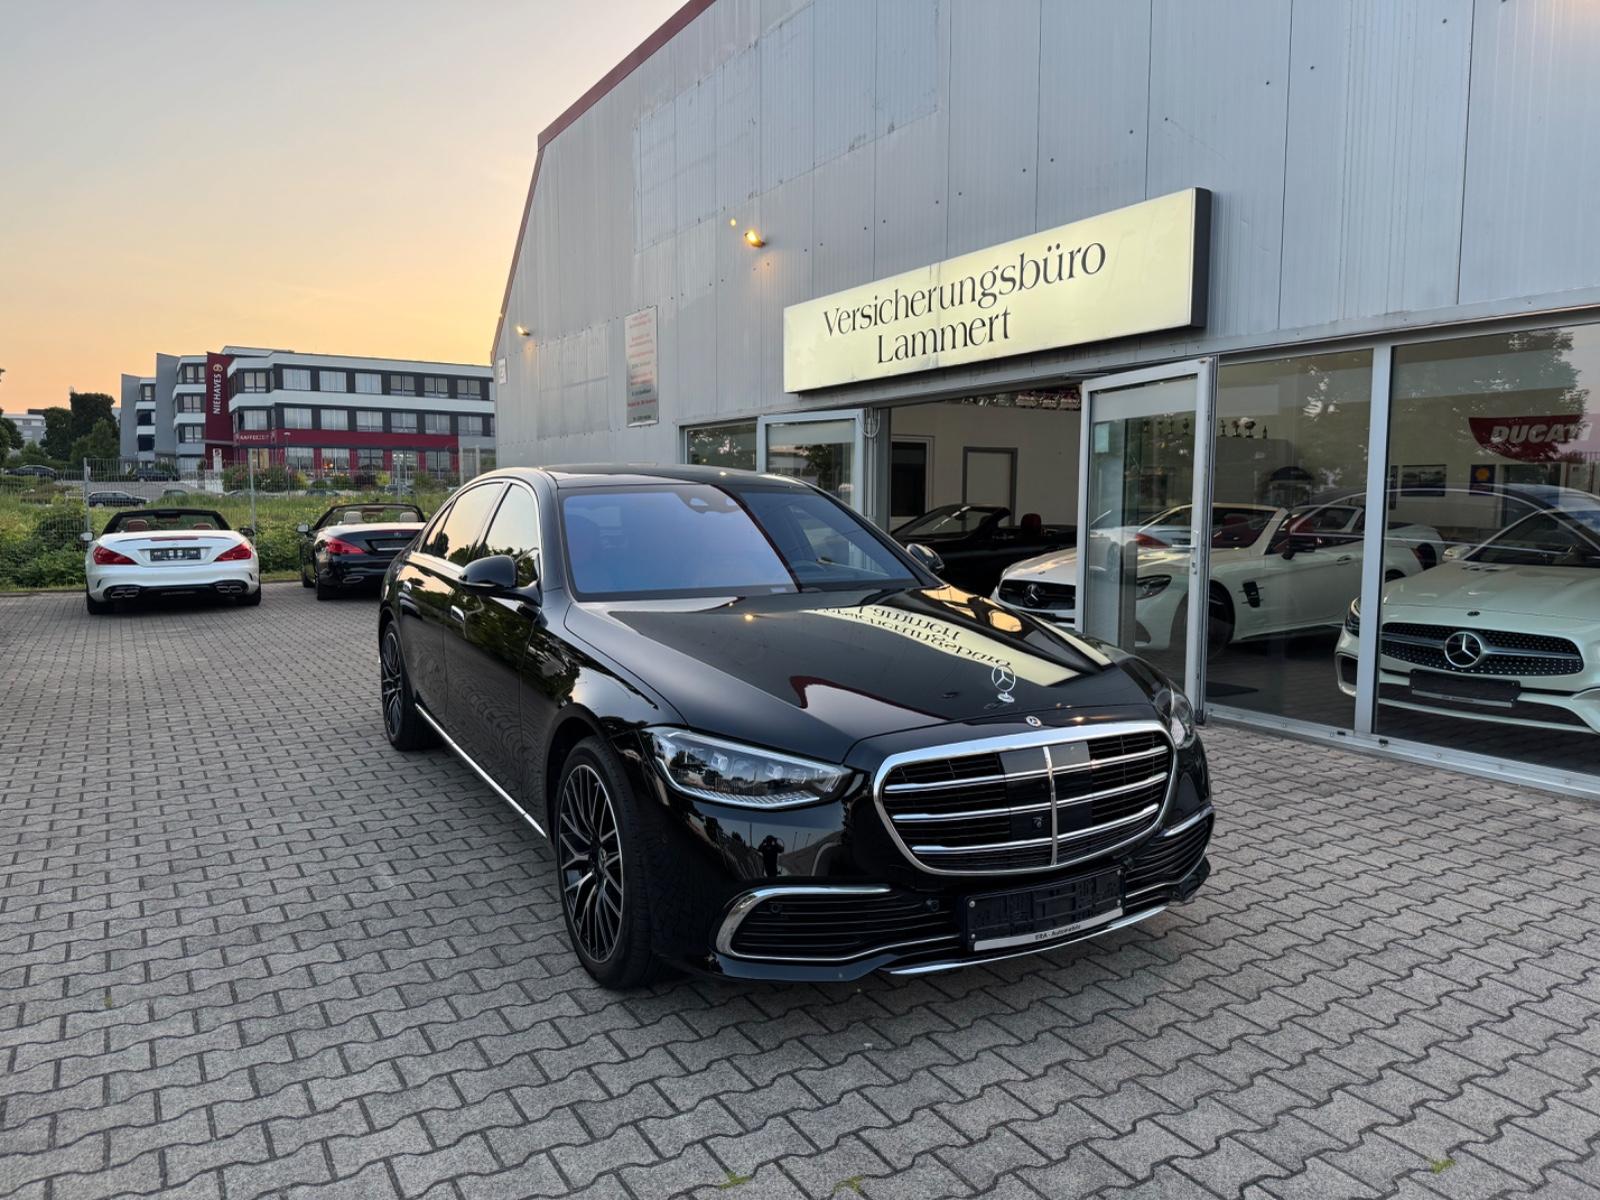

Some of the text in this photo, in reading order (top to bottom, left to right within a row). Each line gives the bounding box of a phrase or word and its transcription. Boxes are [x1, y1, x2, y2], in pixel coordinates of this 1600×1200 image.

[822, 241, 1106, 337] Versicherungsbüro
[877, 307, 1011, 364] Lammert
[213, 373, 222, 414] NIEHAVES
